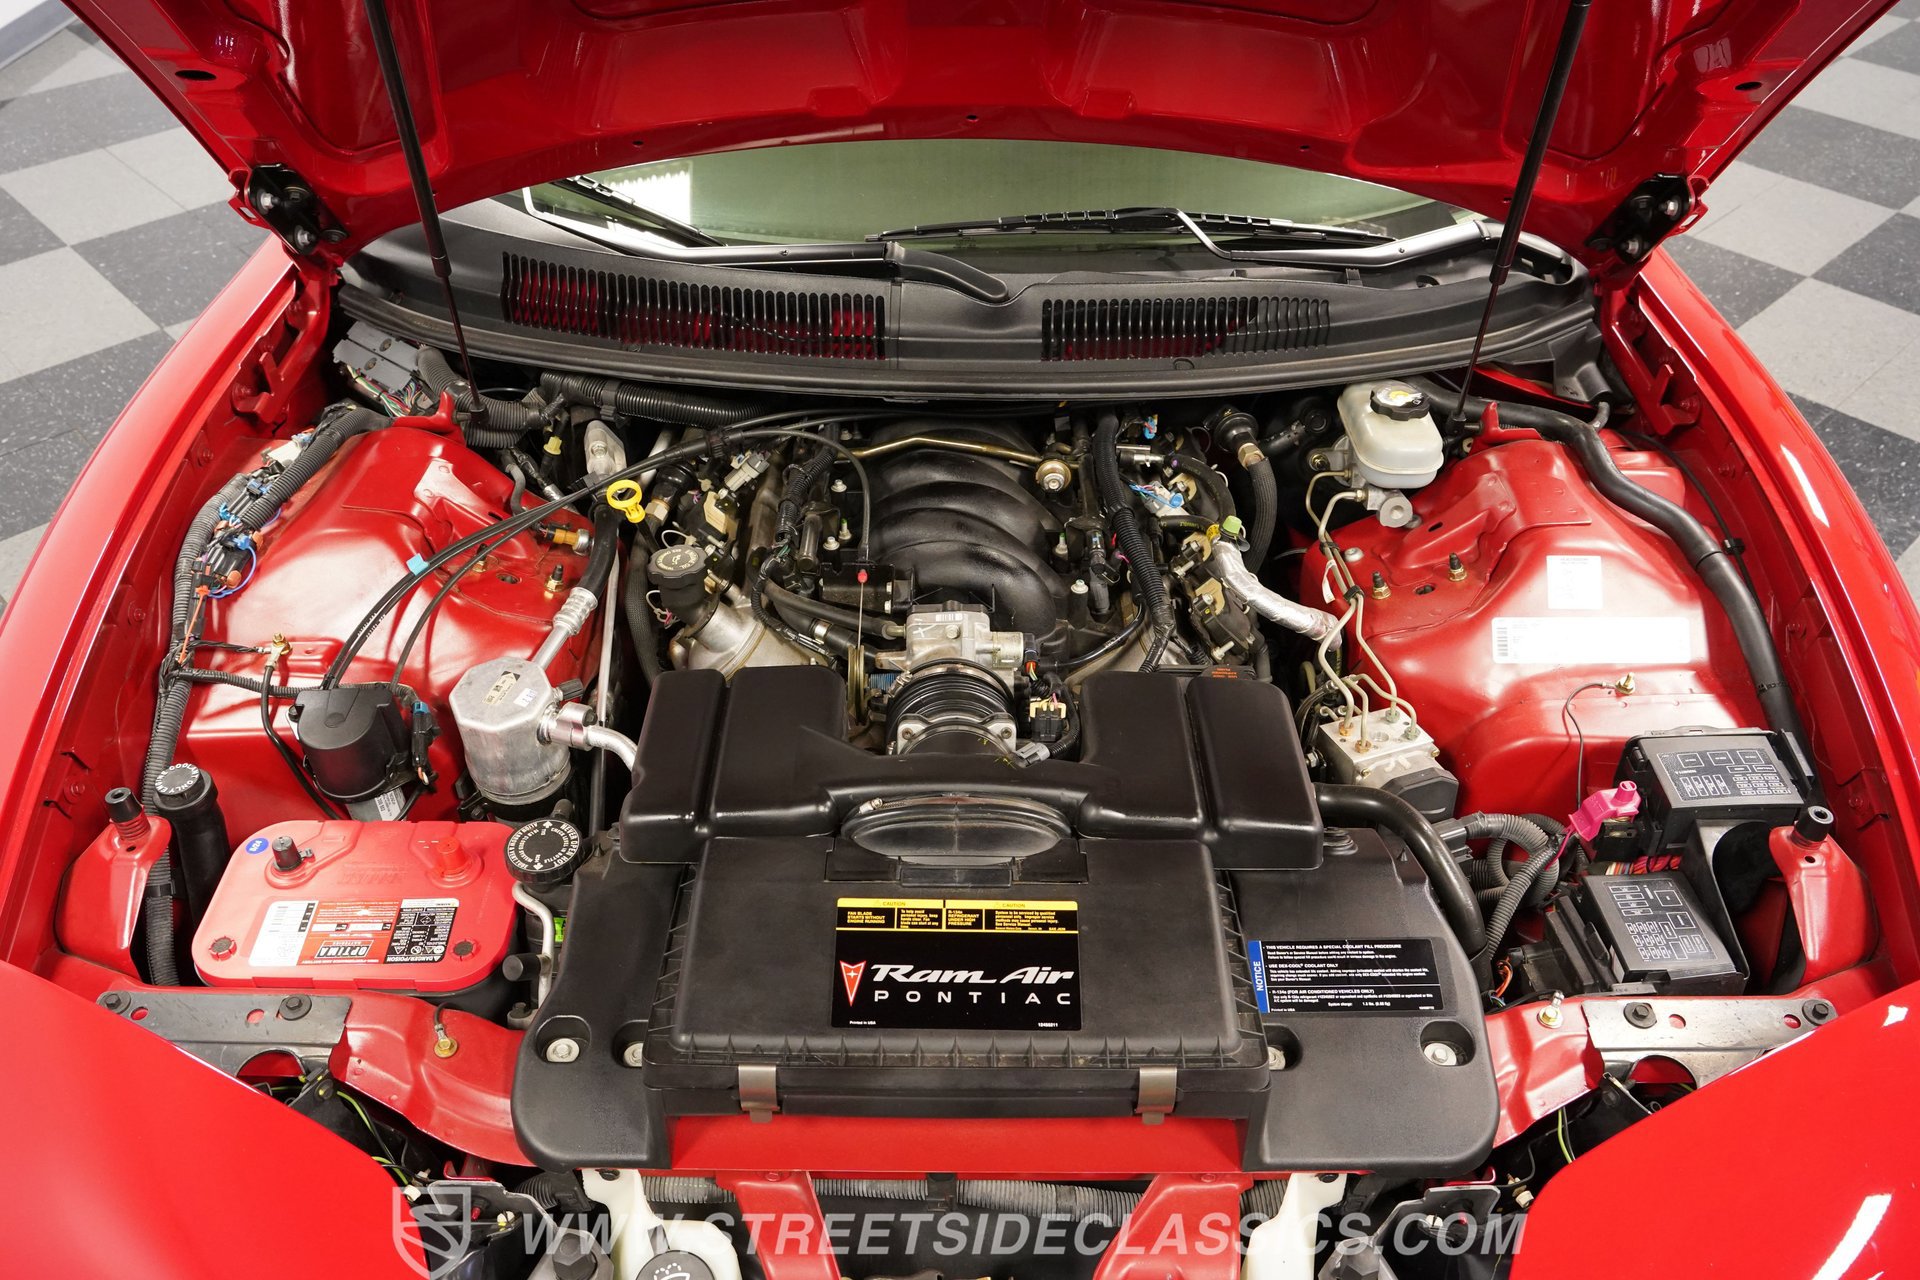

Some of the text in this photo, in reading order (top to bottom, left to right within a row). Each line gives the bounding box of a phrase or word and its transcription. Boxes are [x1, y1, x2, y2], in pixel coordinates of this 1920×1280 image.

[169, 780, 193, 794] ONLY
[553, 823, 579, 867] NEVER OPEN HOT
[319, 946, 368, 957] OPTIMA
[870, 964, 1074, 984] Ram Air
[1253, 961, 1264, 991] NOTICE
[874, 990, 1070, 1005] PONTIAC
